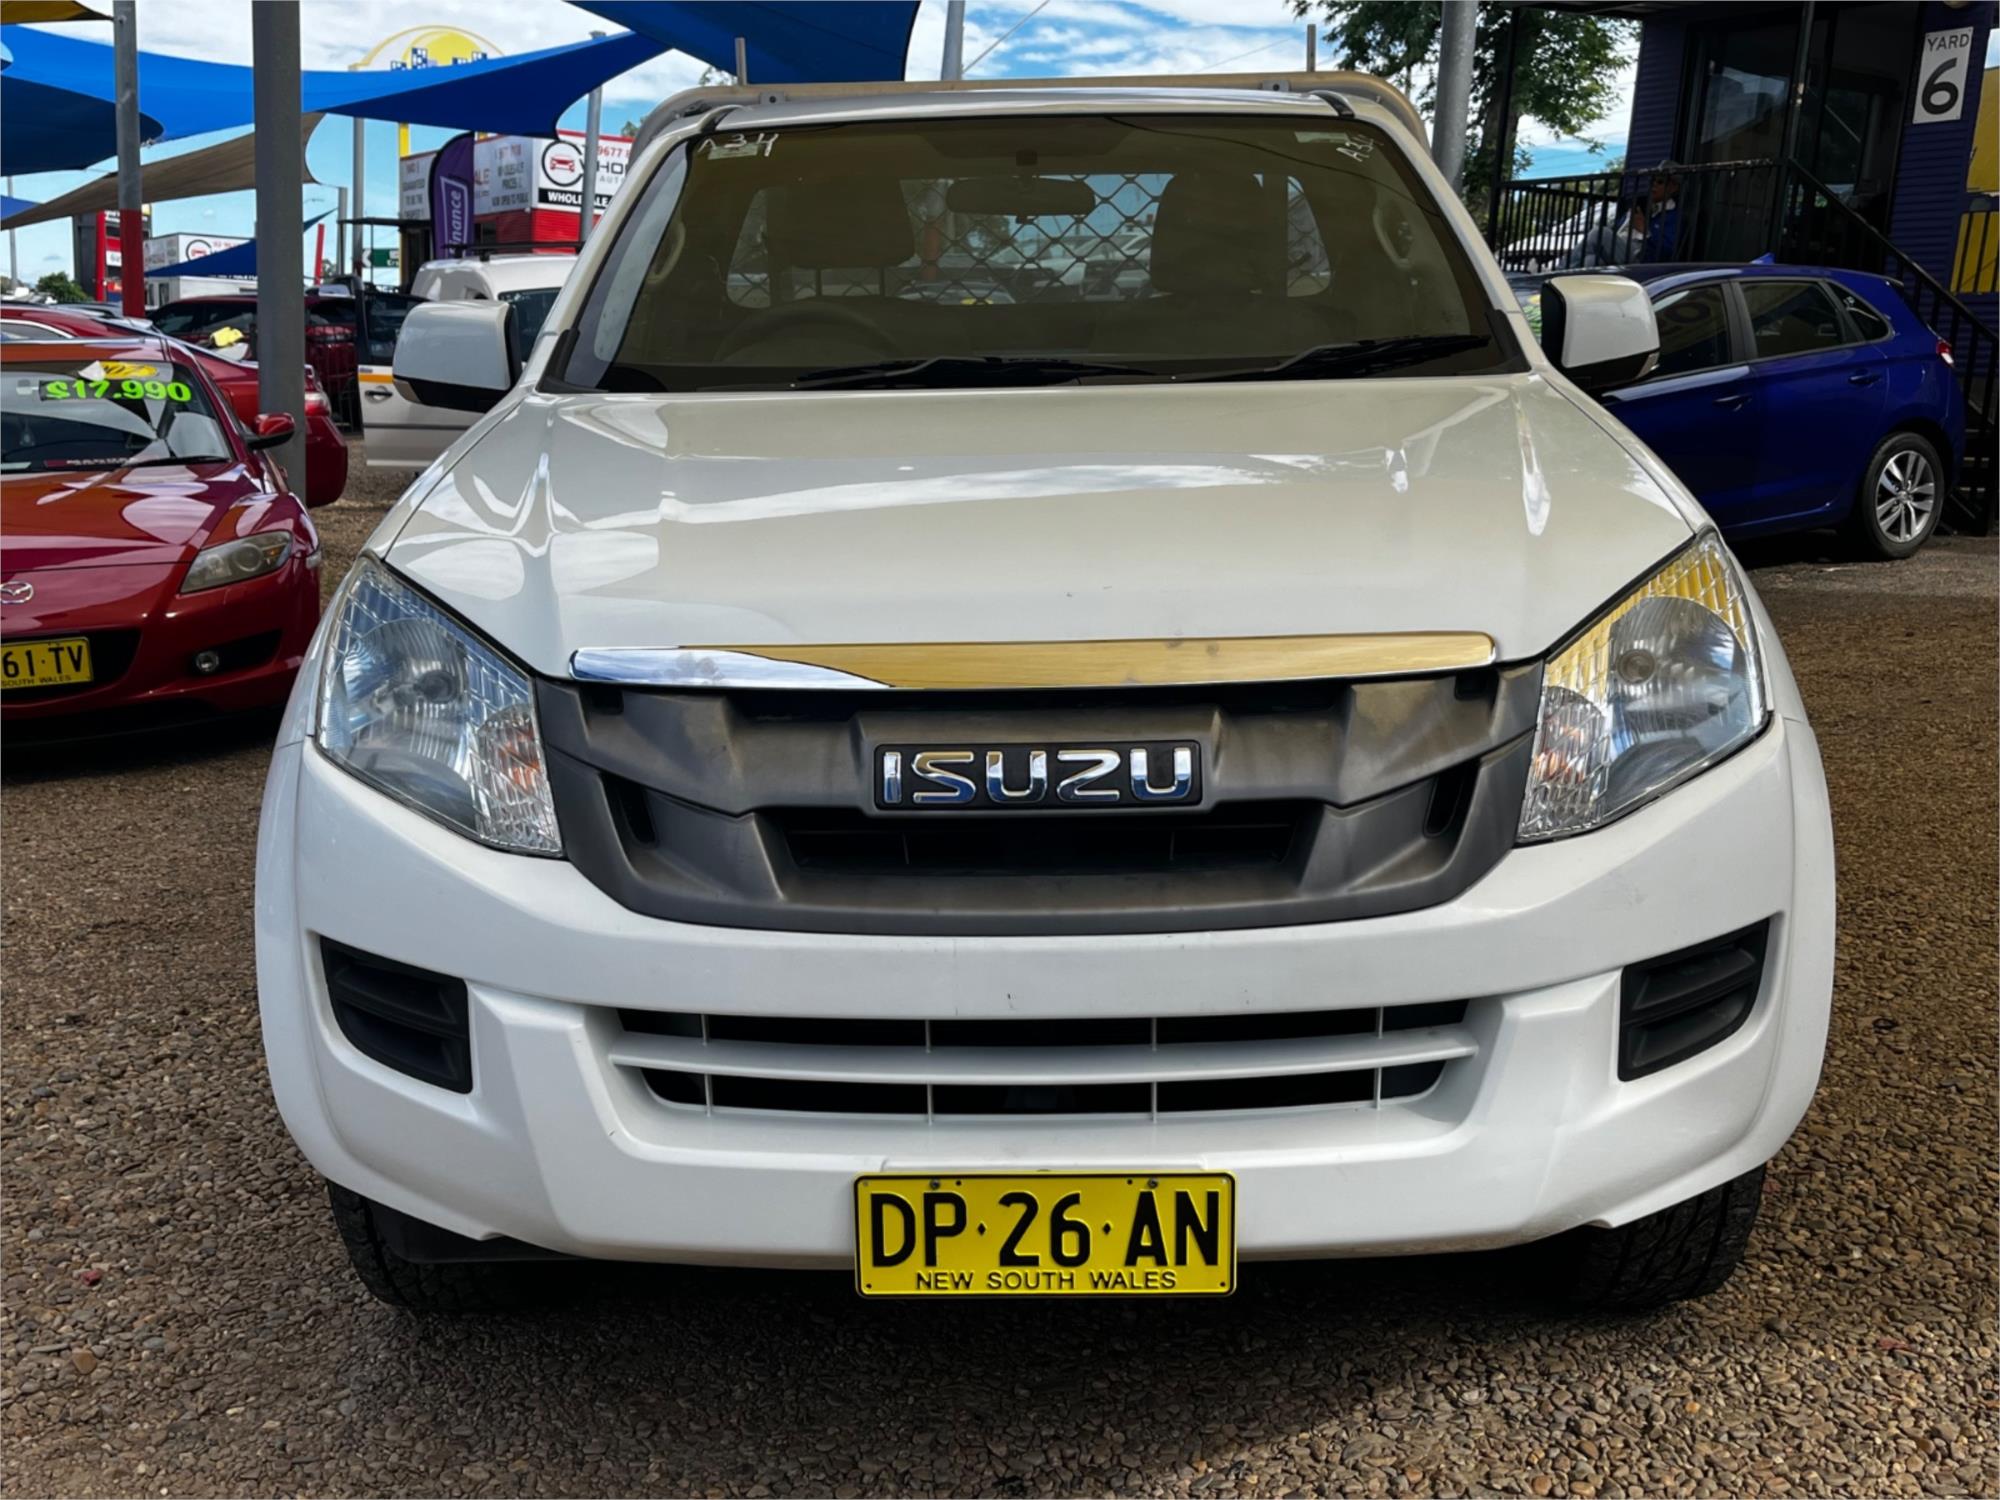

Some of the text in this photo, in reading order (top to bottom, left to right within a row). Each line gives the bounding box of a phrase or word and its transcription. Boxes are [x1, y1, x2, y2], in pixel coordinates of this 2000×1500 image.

[1927, 33, 1971, 52] YARD
[1921, 57, 1959, 115] 6
[883, 747, 1191, 804] ISUZU
[916, 1269, 1177, 1290] NEW SOUTH WALES
